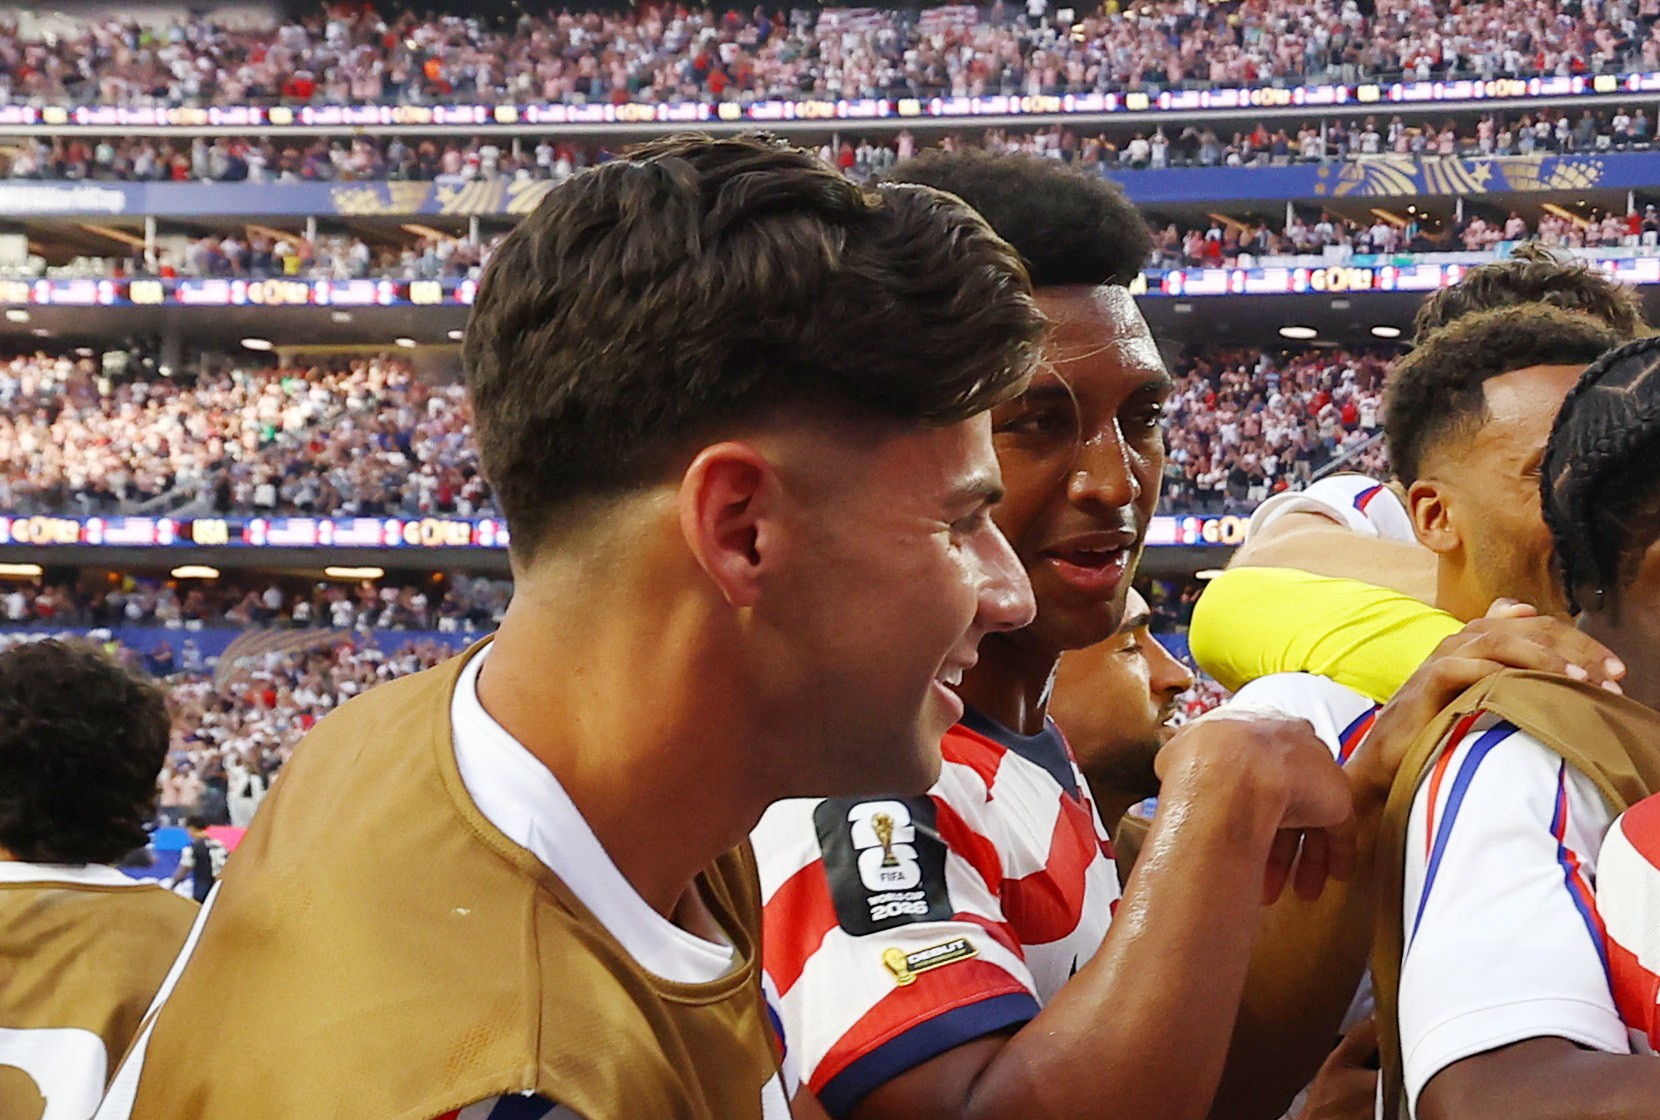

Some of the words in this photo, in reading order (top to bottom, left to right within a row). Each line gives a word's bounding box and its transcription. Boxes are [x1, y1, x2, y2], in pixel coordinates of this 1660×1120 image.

[880, 871, 906, 882] FIFA
[870, 900, 929, 921] 2026
[907, 940, 965, 965] DEBUT
